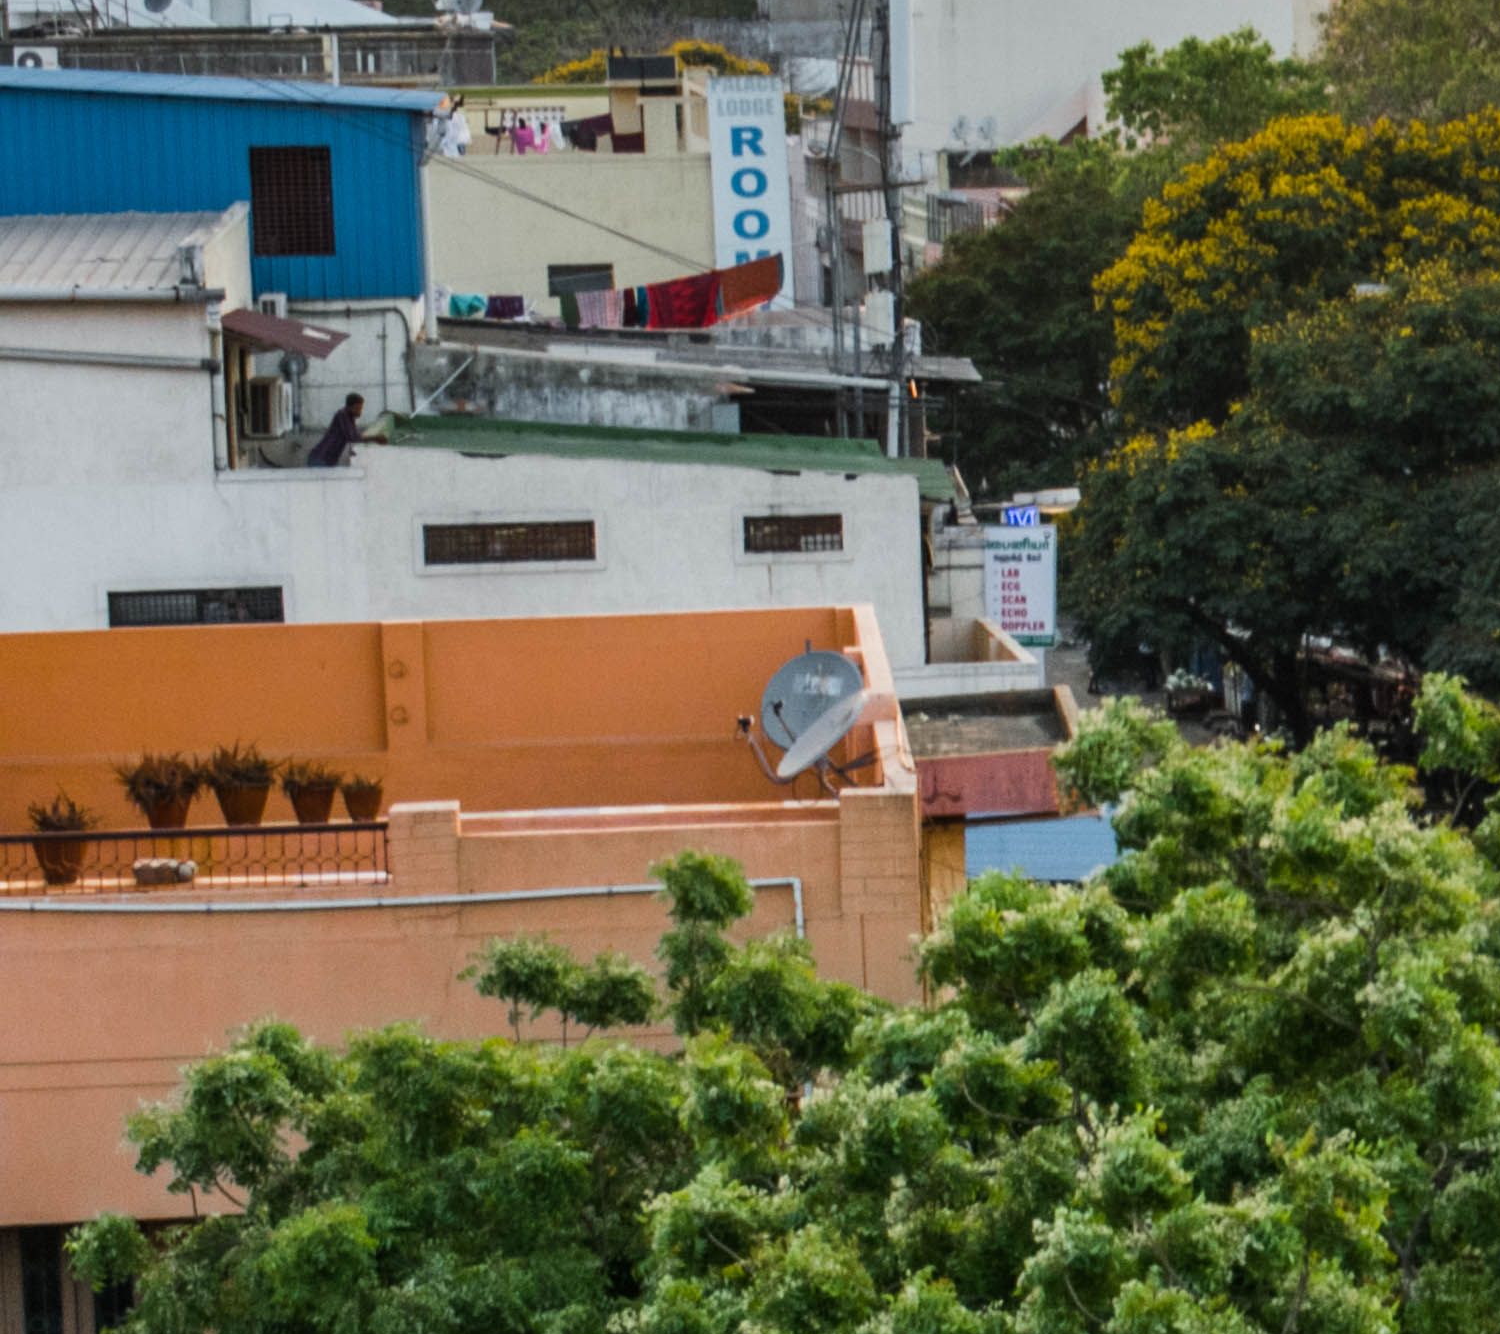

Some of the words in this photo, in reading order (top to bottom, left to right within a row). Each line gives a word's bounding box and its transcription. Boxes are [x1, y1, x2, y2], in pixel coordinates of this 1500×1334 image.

[716, 97, 776, 116] LODGE
[1001, 569, 1020, 578] LAB
[1001, 595, 1027, 605] SCAN
[1001, 620, 1046, 631] DOPPLER
